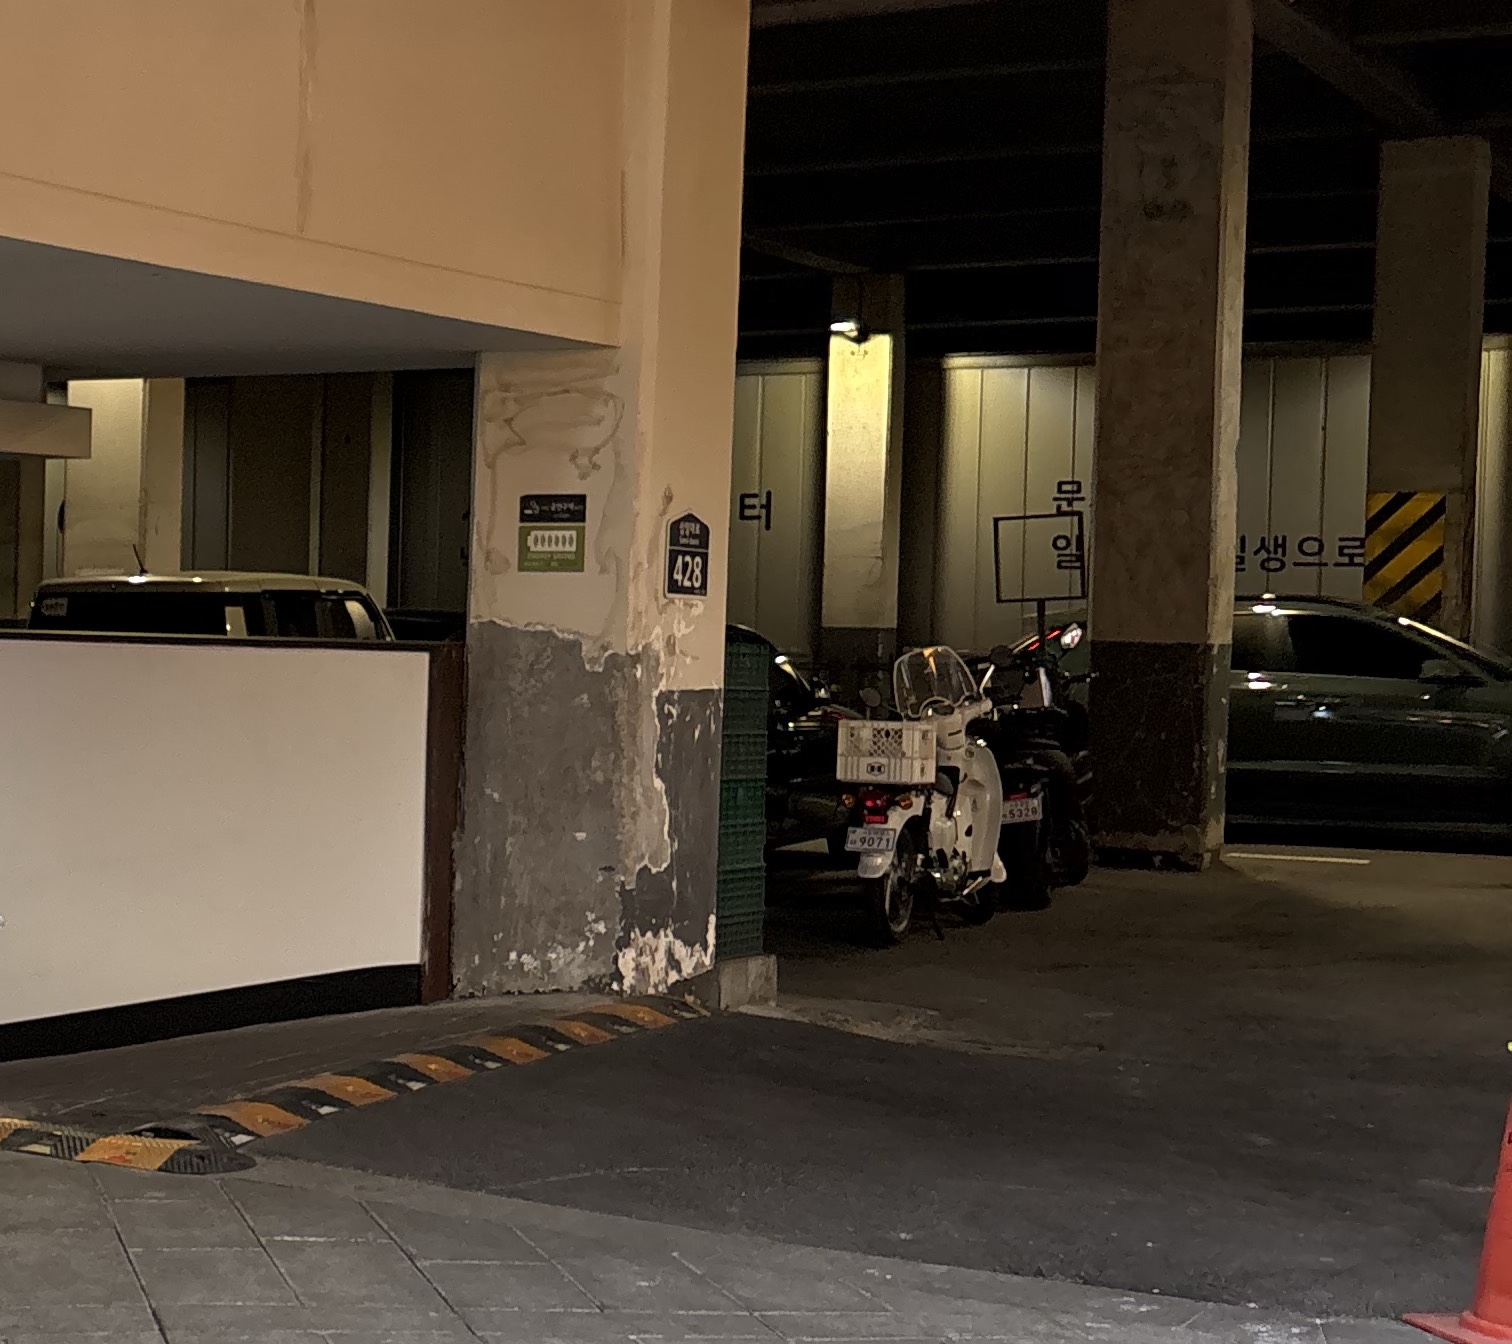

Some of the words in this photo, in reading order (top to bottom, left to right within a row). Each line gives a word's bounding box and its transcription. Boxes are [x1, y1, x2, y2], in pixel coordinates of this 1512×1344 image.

[739, 490, 772, 531] 터
[1052, 480, 1085, 515] 문
[673, 554, 703, 589] 428
[859, 836, 890, 848] 9071
